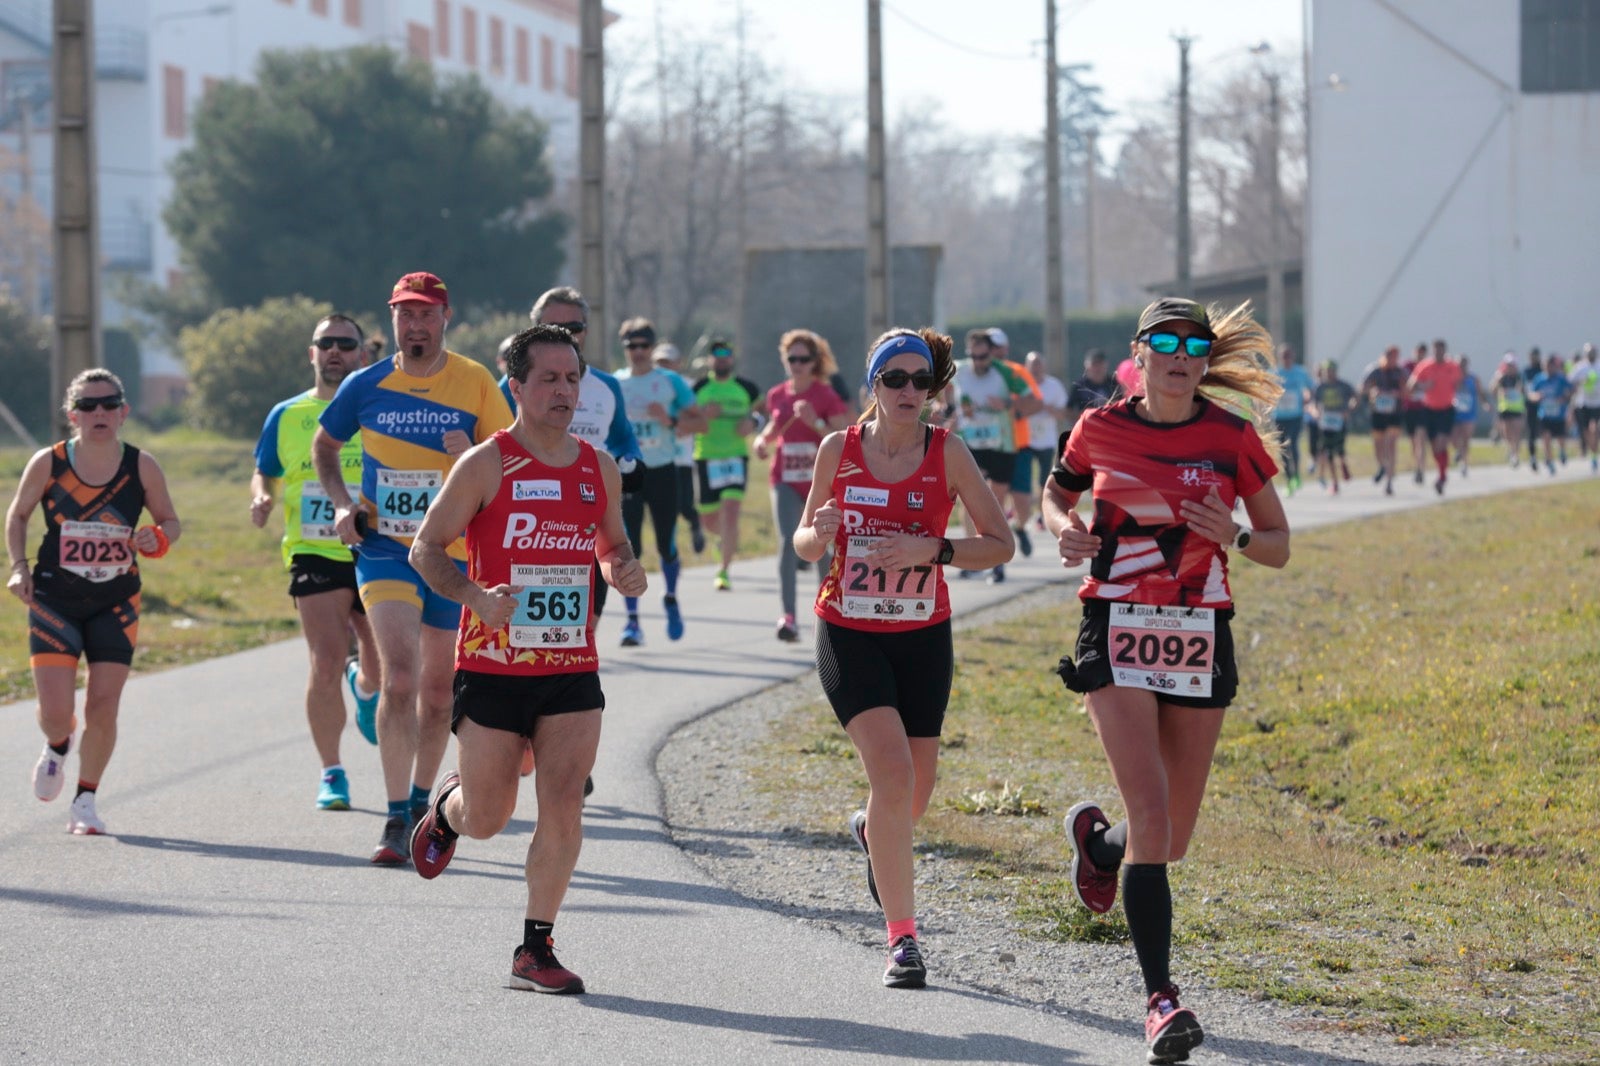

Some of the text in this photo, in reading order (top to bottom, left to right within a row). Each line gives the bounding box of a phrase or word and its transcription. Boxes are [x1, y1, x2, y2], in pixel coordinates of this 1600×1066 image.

[377, 408, 460, 428] agustinos
[386, 426, 447, 434] GRANADA
[568, 426, 600, 435] ACENA
[310, 500, 336, 521] 75
[385, 491, 430, 516] 484
[541, 520, 579, 532] Clínicas
[64, 540, 128, 562] 2023
[535, 567, 549, 576] GRAN
[550, 567, 569, 576] PREMIO
[570, 567, 576, 576] DE
[848, 562, 933, 594] 2177
[526, 591, 581, 622] 563
[1115, 632, 1209, 667] 2092
